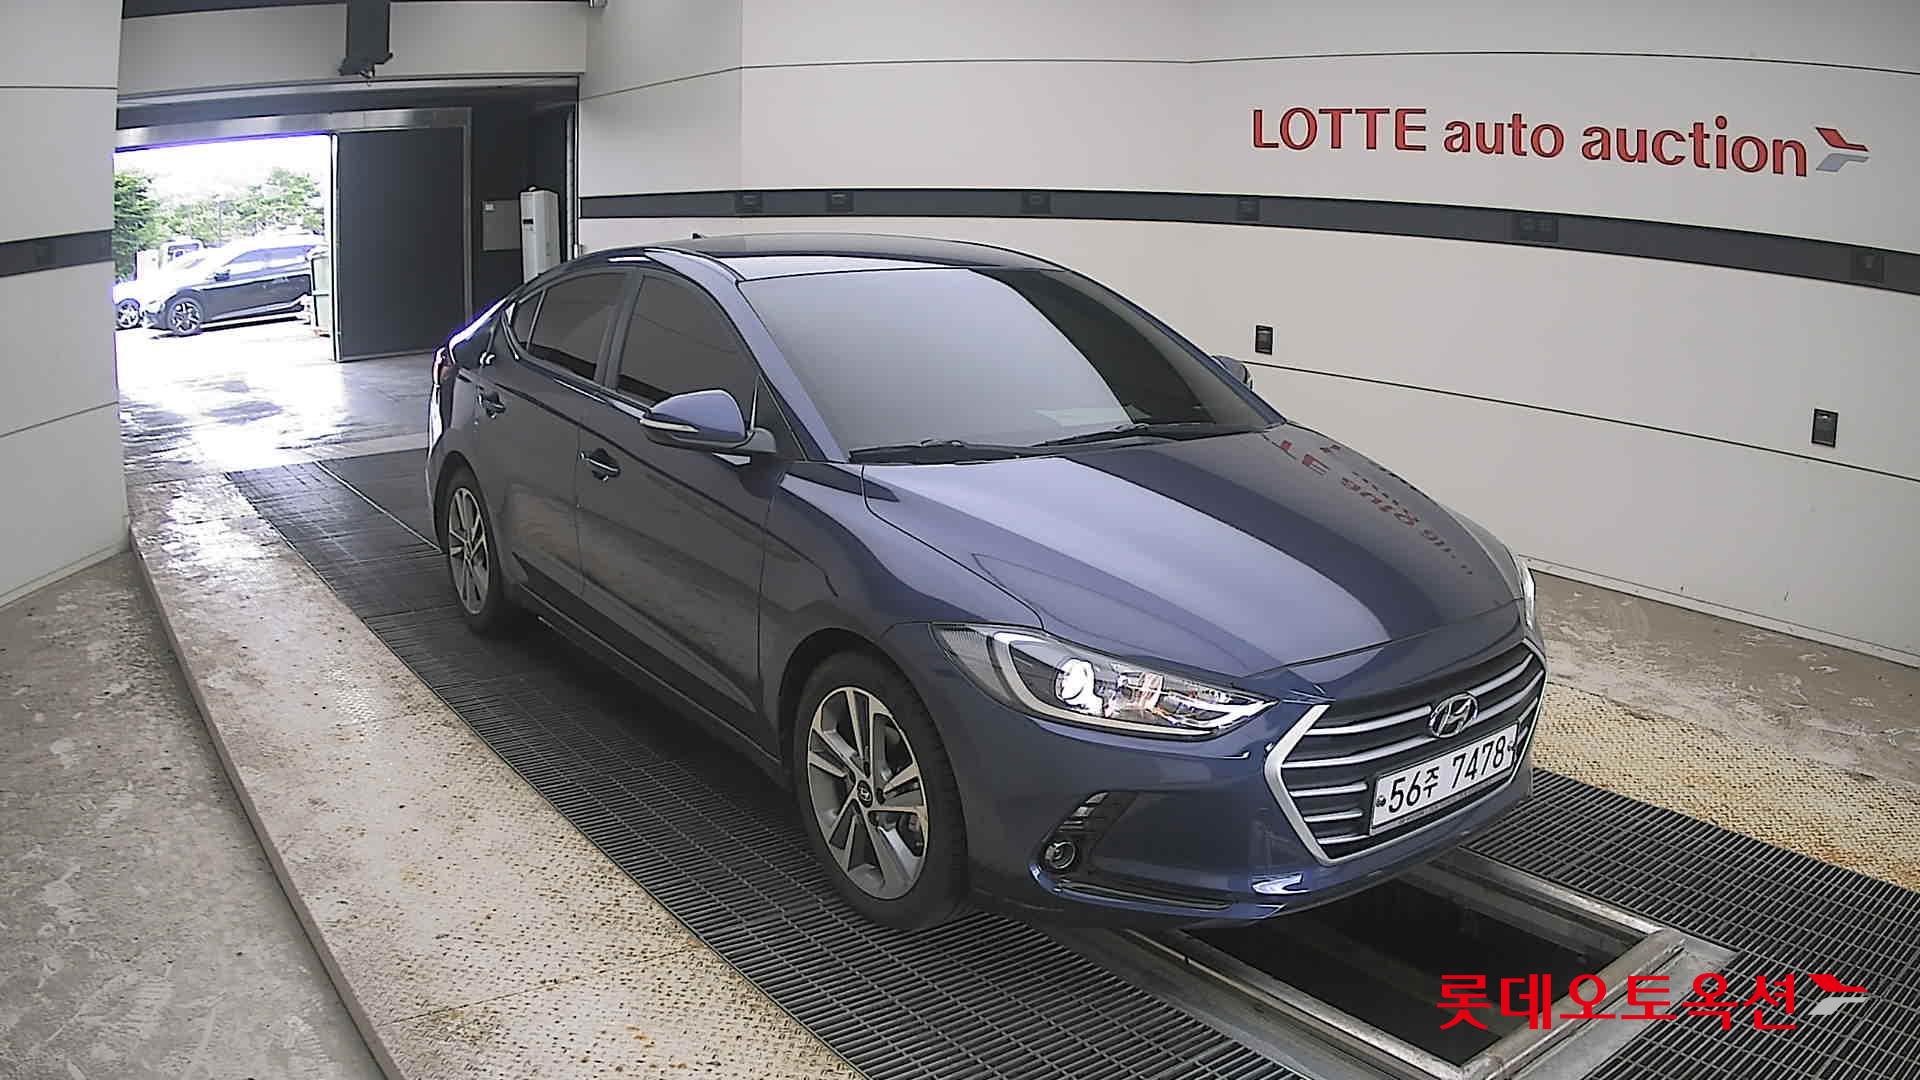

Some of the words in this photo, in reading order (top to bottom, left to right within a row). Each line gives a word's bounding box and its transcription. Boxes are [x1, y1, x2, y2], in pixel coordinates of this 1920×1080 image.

[1253, 107, 1427, 151] LOTTE
[1443, 113, 1565, 158] auto
[1582, 116, 1808, 177] auction
[1388, 766, 1440, 813] 56주
[1451, 735, 1506, 789] 7478
